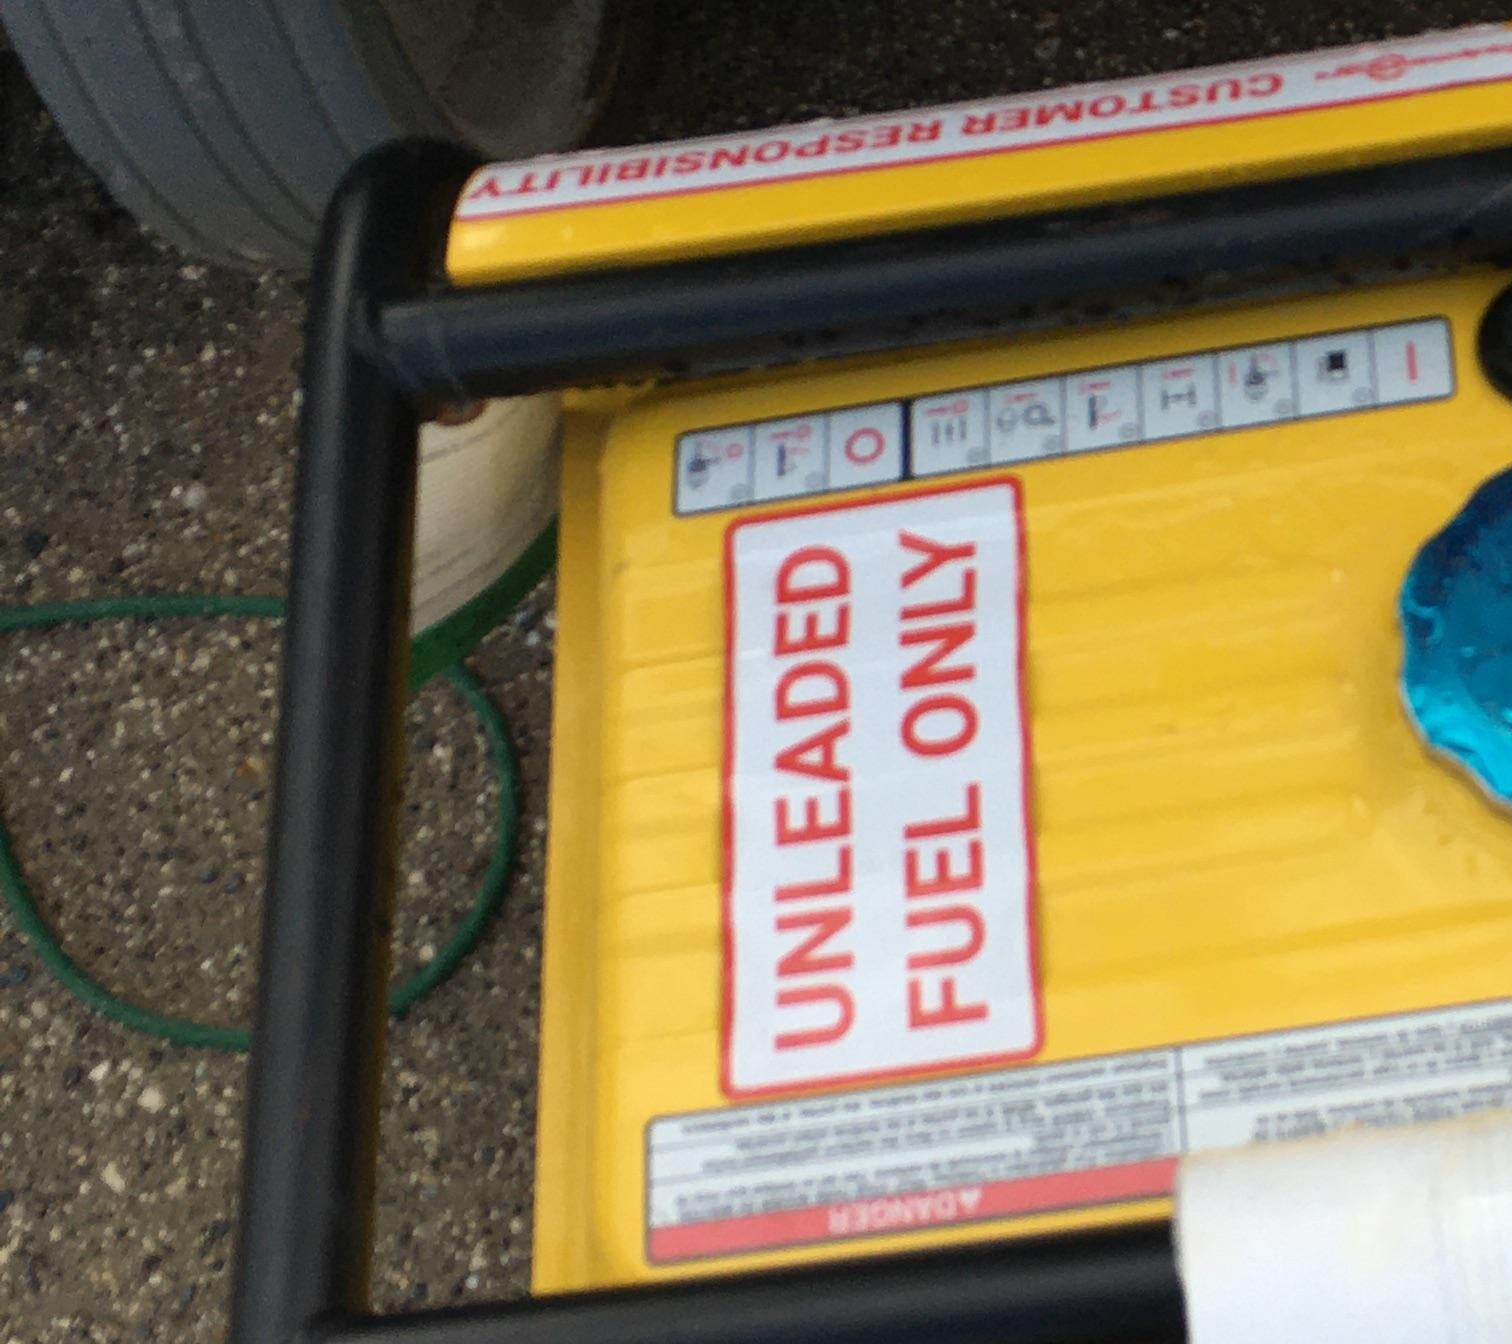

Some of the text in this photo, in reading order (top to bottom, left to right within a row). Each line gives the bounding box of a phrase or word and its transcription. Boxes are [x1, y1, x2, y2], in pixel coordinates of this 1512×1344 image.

[469, 72, 1284, 200] CUSTOMER RESPONSIBILITY
[774, 542, 856, 1052] UNLEADED
[898, 528, 990, 1031] FUEL ONLY
[827, 1195, 957, 1235] DANGER
